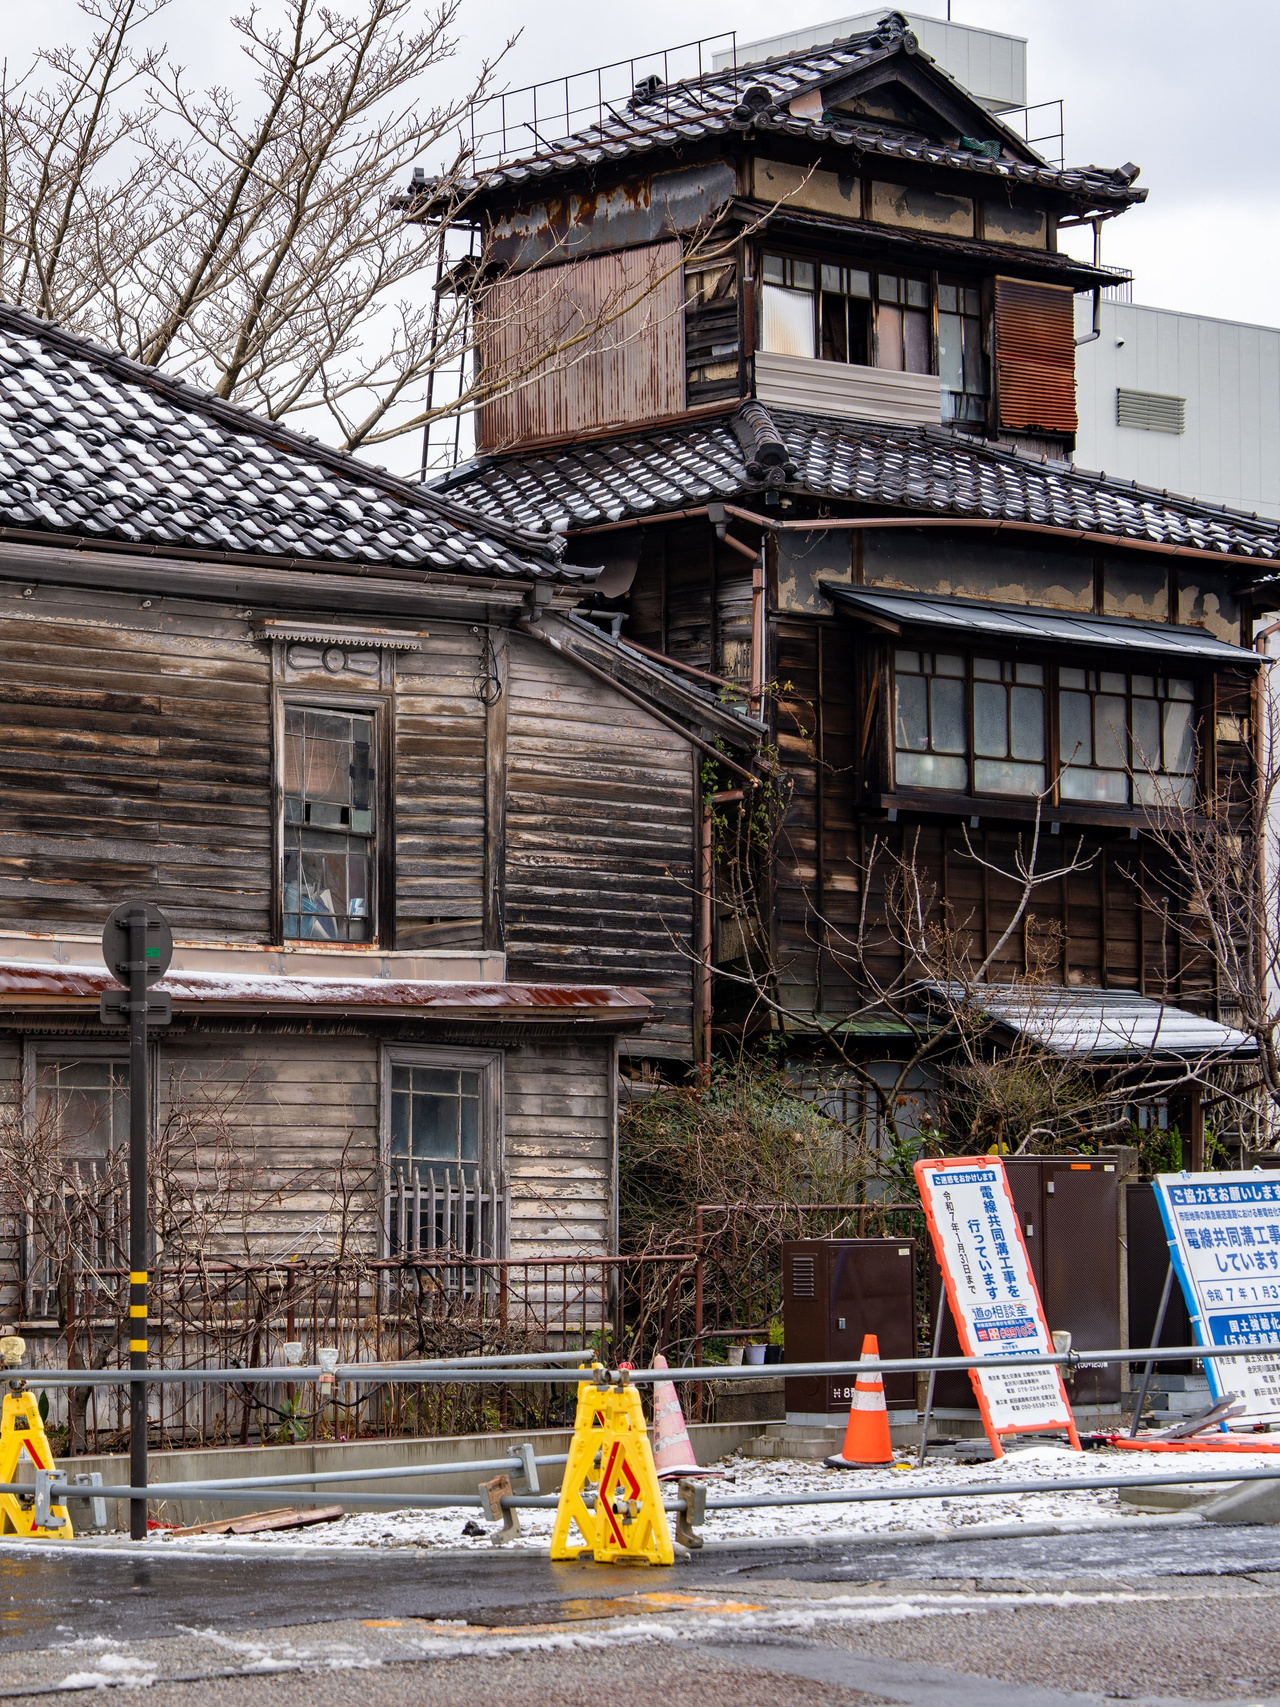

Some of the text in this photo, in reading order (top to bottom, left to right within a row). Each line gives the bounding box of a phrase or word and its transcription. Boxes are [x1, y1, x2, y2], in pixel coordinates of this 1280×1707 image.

[934, 1173, 994, 1185] ご迷惑をおかけします
[1173, 1184, 1280, 1203] ご協力をお願いします
[1178, 1207, 1280, 1221] 市街地等の緊急輸送道路における無電柱化
[943, 1191, 976, 1294] 令和7年1月31日まで
[980, 1186, 1020, 1298] 電線共同溝工事を
[1184, 1224, 1280, 1249] 電線共同溝工事
[967, 1219, 998, 1300] 行っています
[1215, 1250, 1278, 1272] しています
[1224, 1331, 1280, 1346] (5か年加速
